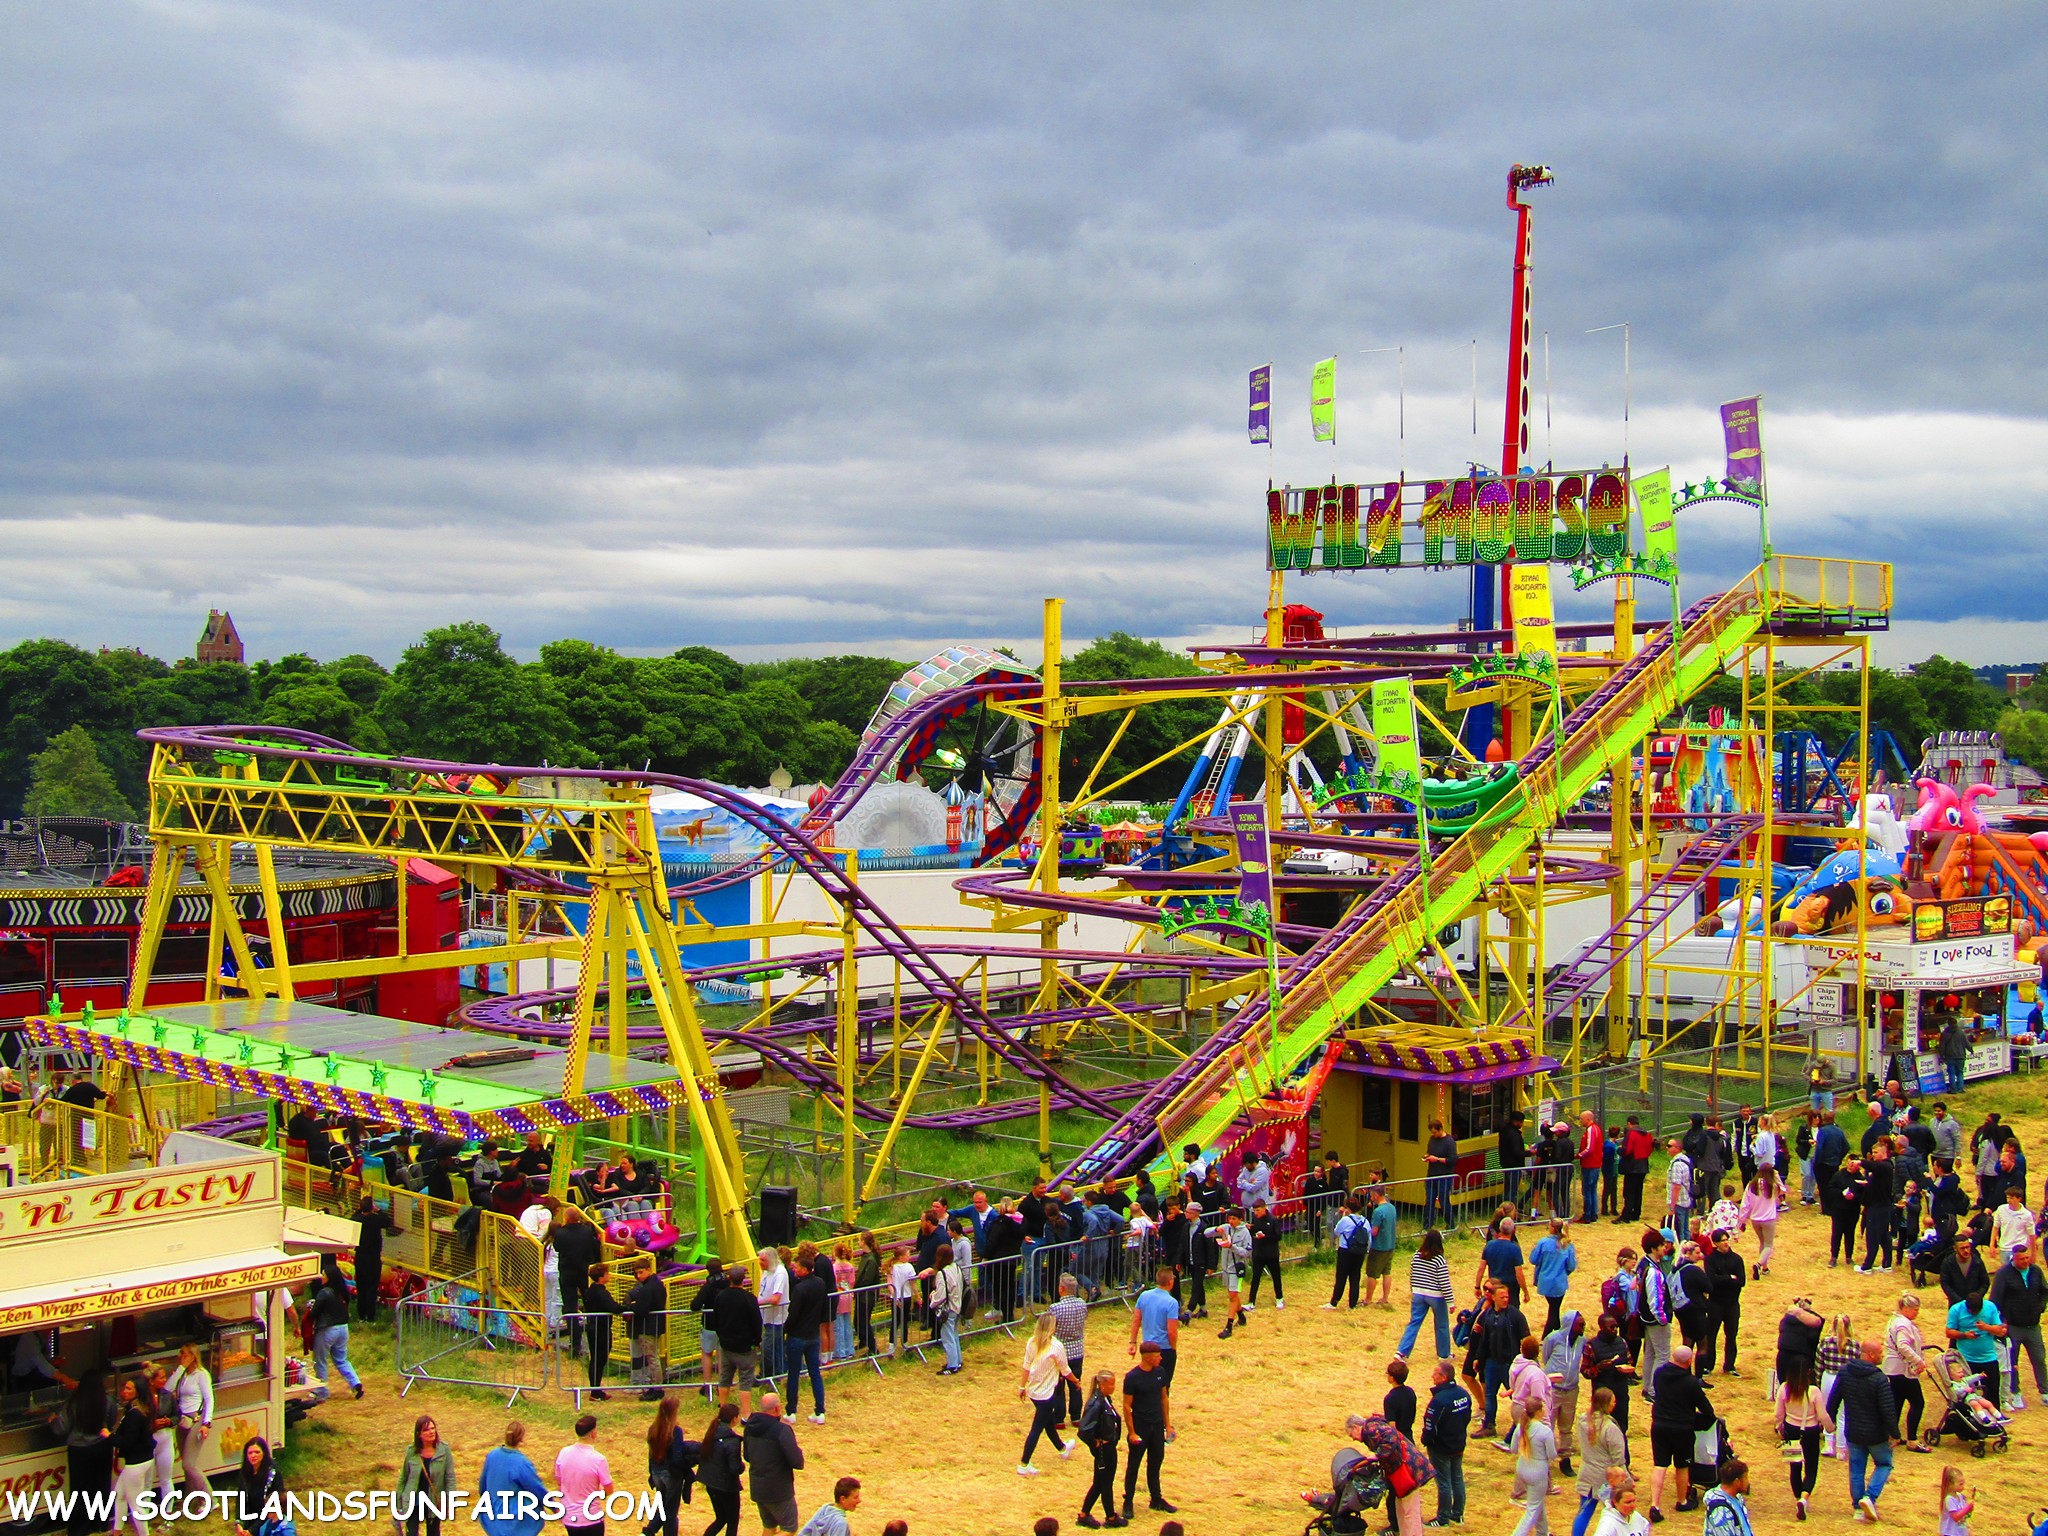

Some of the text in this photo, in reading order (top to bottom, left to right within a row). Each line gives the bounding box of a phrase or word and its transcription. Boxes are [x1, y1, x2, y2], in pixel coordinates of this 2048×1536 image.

[1946, 902, 1981, 914] SIZZLING
[1809, 945, 1827, 953] Fully
[1934, 949, 1962, 966] Love
[1614, 1016, 1623, 1025] P1
[1969, 1063, 1985, 1072] Burger
[560, 1163, 569, 1189] HERE
[91, 1171, 256, 1219] Tasty
[37, 1299, 86, 1318] Wraps
[98, 1293, 126, 1309] Hot
[132, 1290, 143, 1302] &
[147, 1284, 177, 1301] Cold
[180, 1276, 228, 1296] Drinks
[239, 1269, 266, 1286] Hot
[270, 1264, 303, 1280] Dogs
[1453, 1397, 1467, 1406] tyco
